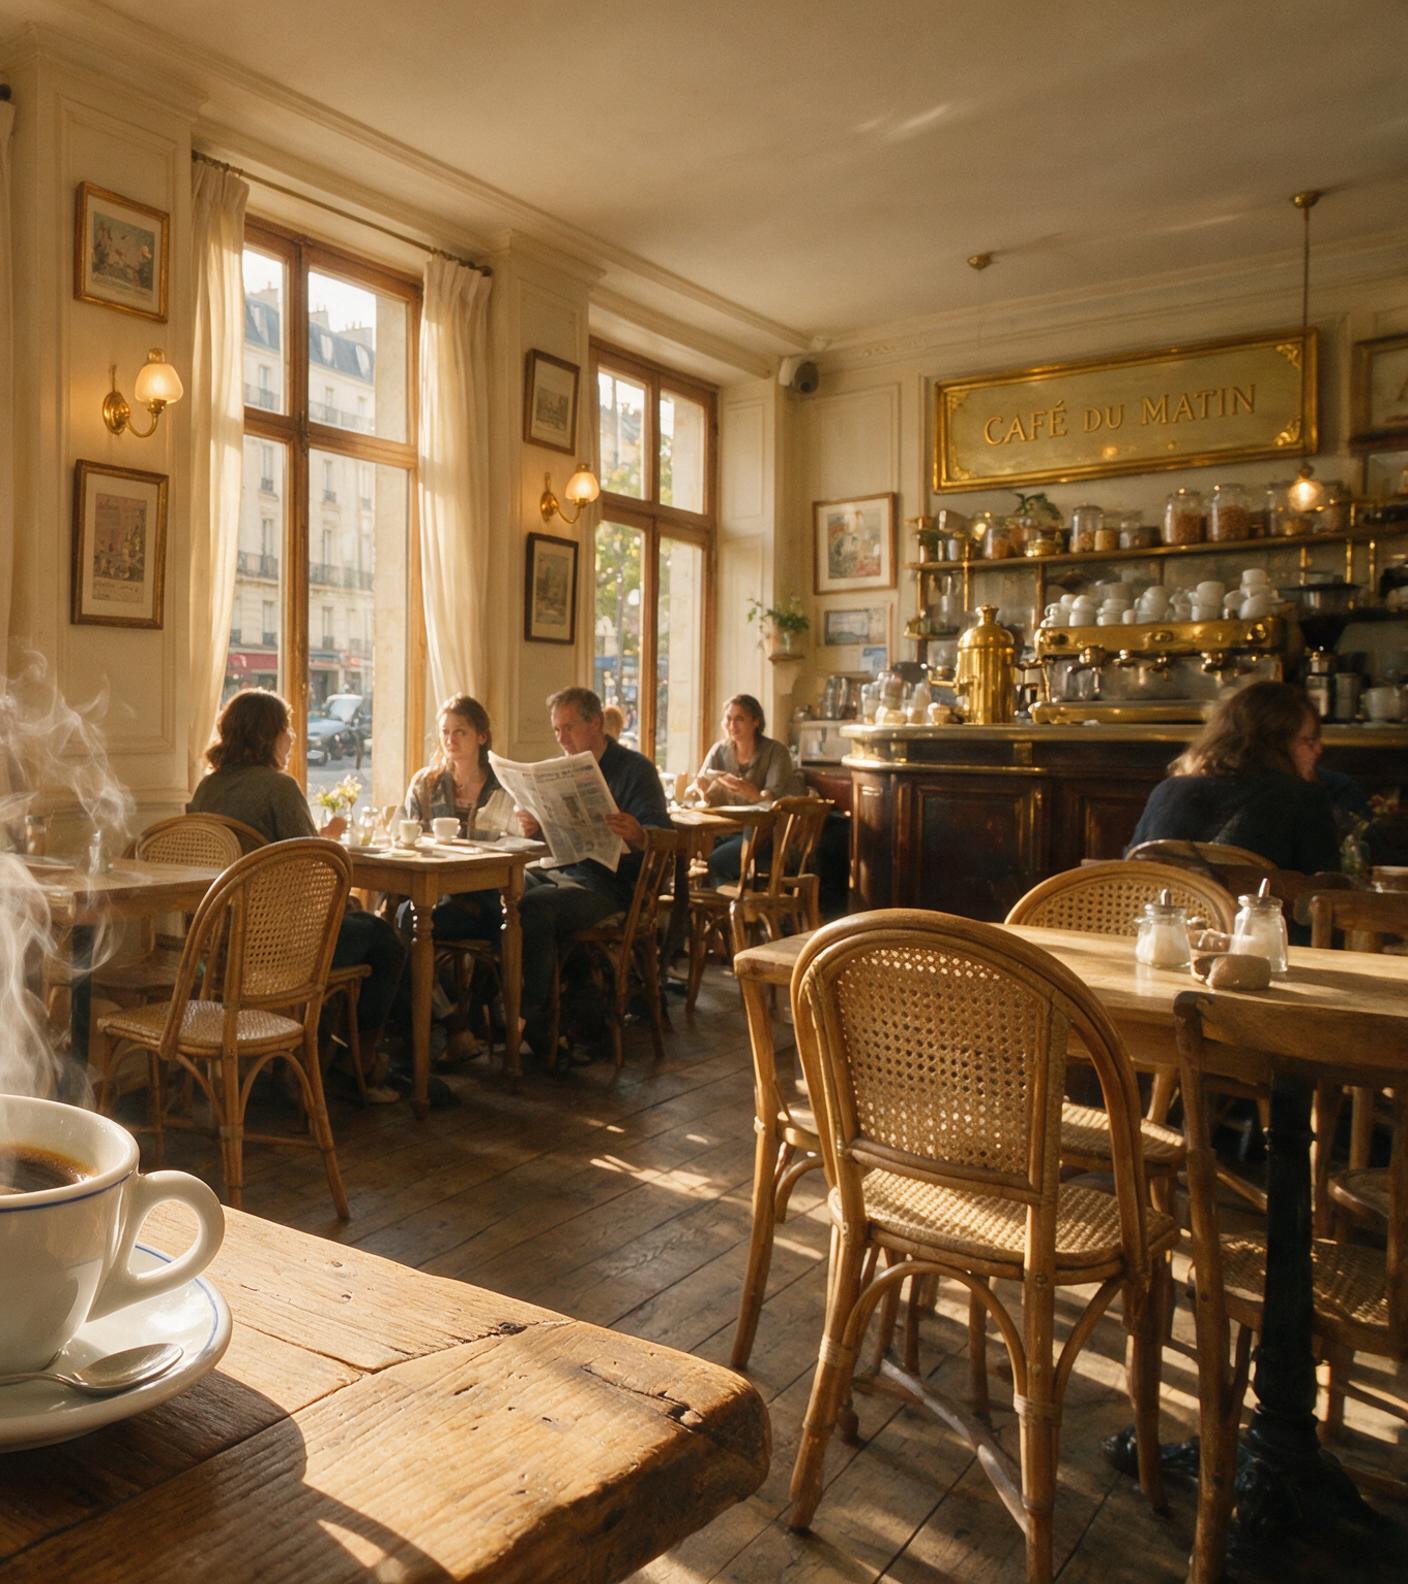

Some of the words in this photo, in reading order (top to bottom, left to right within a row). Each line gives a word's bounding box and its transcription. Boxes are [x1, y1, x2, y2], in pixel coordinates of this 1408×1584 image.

[983, 400, 1069, 446] CAFÉ
[1083, 404, 1125, 433] DU
[1141, 384, 1257, 426] MATIN
